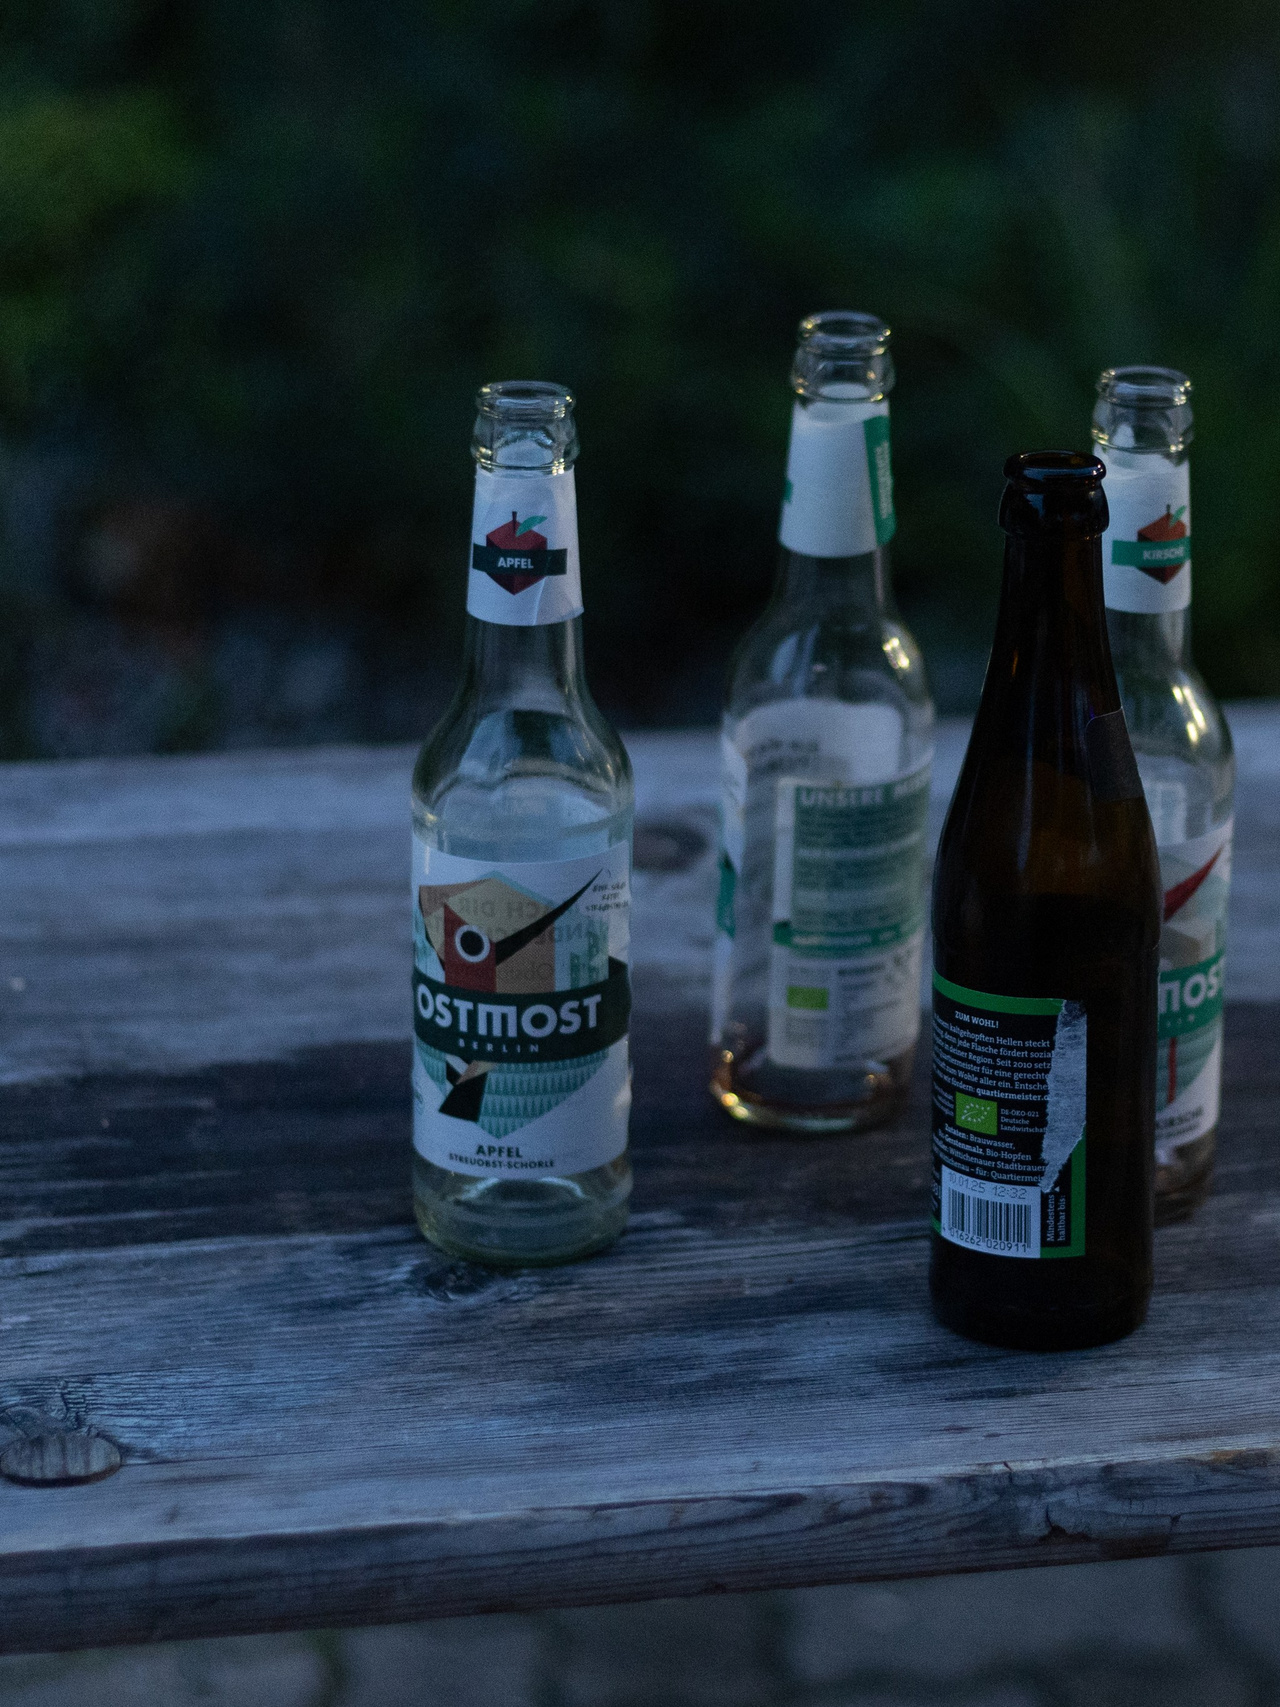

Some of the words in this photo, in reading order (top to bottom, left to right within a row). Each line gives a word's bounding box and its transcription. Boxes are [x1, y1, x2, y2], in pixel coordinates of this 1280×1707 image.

[497, 557, 534, 569] APFEL
[417, 983, 602, 1038] OSTMOST
[955, 1010, 970, 1023] ZUM
[971, 1016, 999, 1028] WOHL!
[458, 1038, 540, 1053] BERLIN
[957, 1038, 970, 1048] jede
[971, 1042, 998, 1055] Flasche
[1000, 1048, 1028, 1058] fördert
[996, 1036, 1023, 1047] Hellen
[1024, 1039, 1050, 1048] steckt
[968, 1052, 995, 1064] Region.
[996, 1058, 1011, 1067] Seit
[1013, 1061, 1033, 1069] 2010
[957, 1069, 978, 1083] Wohle
[979, 1076, 997, 1086] aller
[998, 1080, 1013, 1089] ein.
[981, 1066, 993, 1075] für
[994, 1069, 1012, 1077] eine
[1000, 1117, 1030, 1125] Deutsche
[969, 1133, 1016, 1150] Brauwasser,
[476, 1145, 523, 1158] APFEL
[986, 1148, 1032, 1162] Bio-Hopfen
[975, 1167, 989, 1177] für:
[992, 1185, 1027, 1199] 12:32
[1046, 1194, 1055, 1242] Mindestens
[1057, 1212, 1066, 1242] haltbar
[949, 1226, 982, 1246] 016262
[986, 1241, 1027, 1253] 020911
